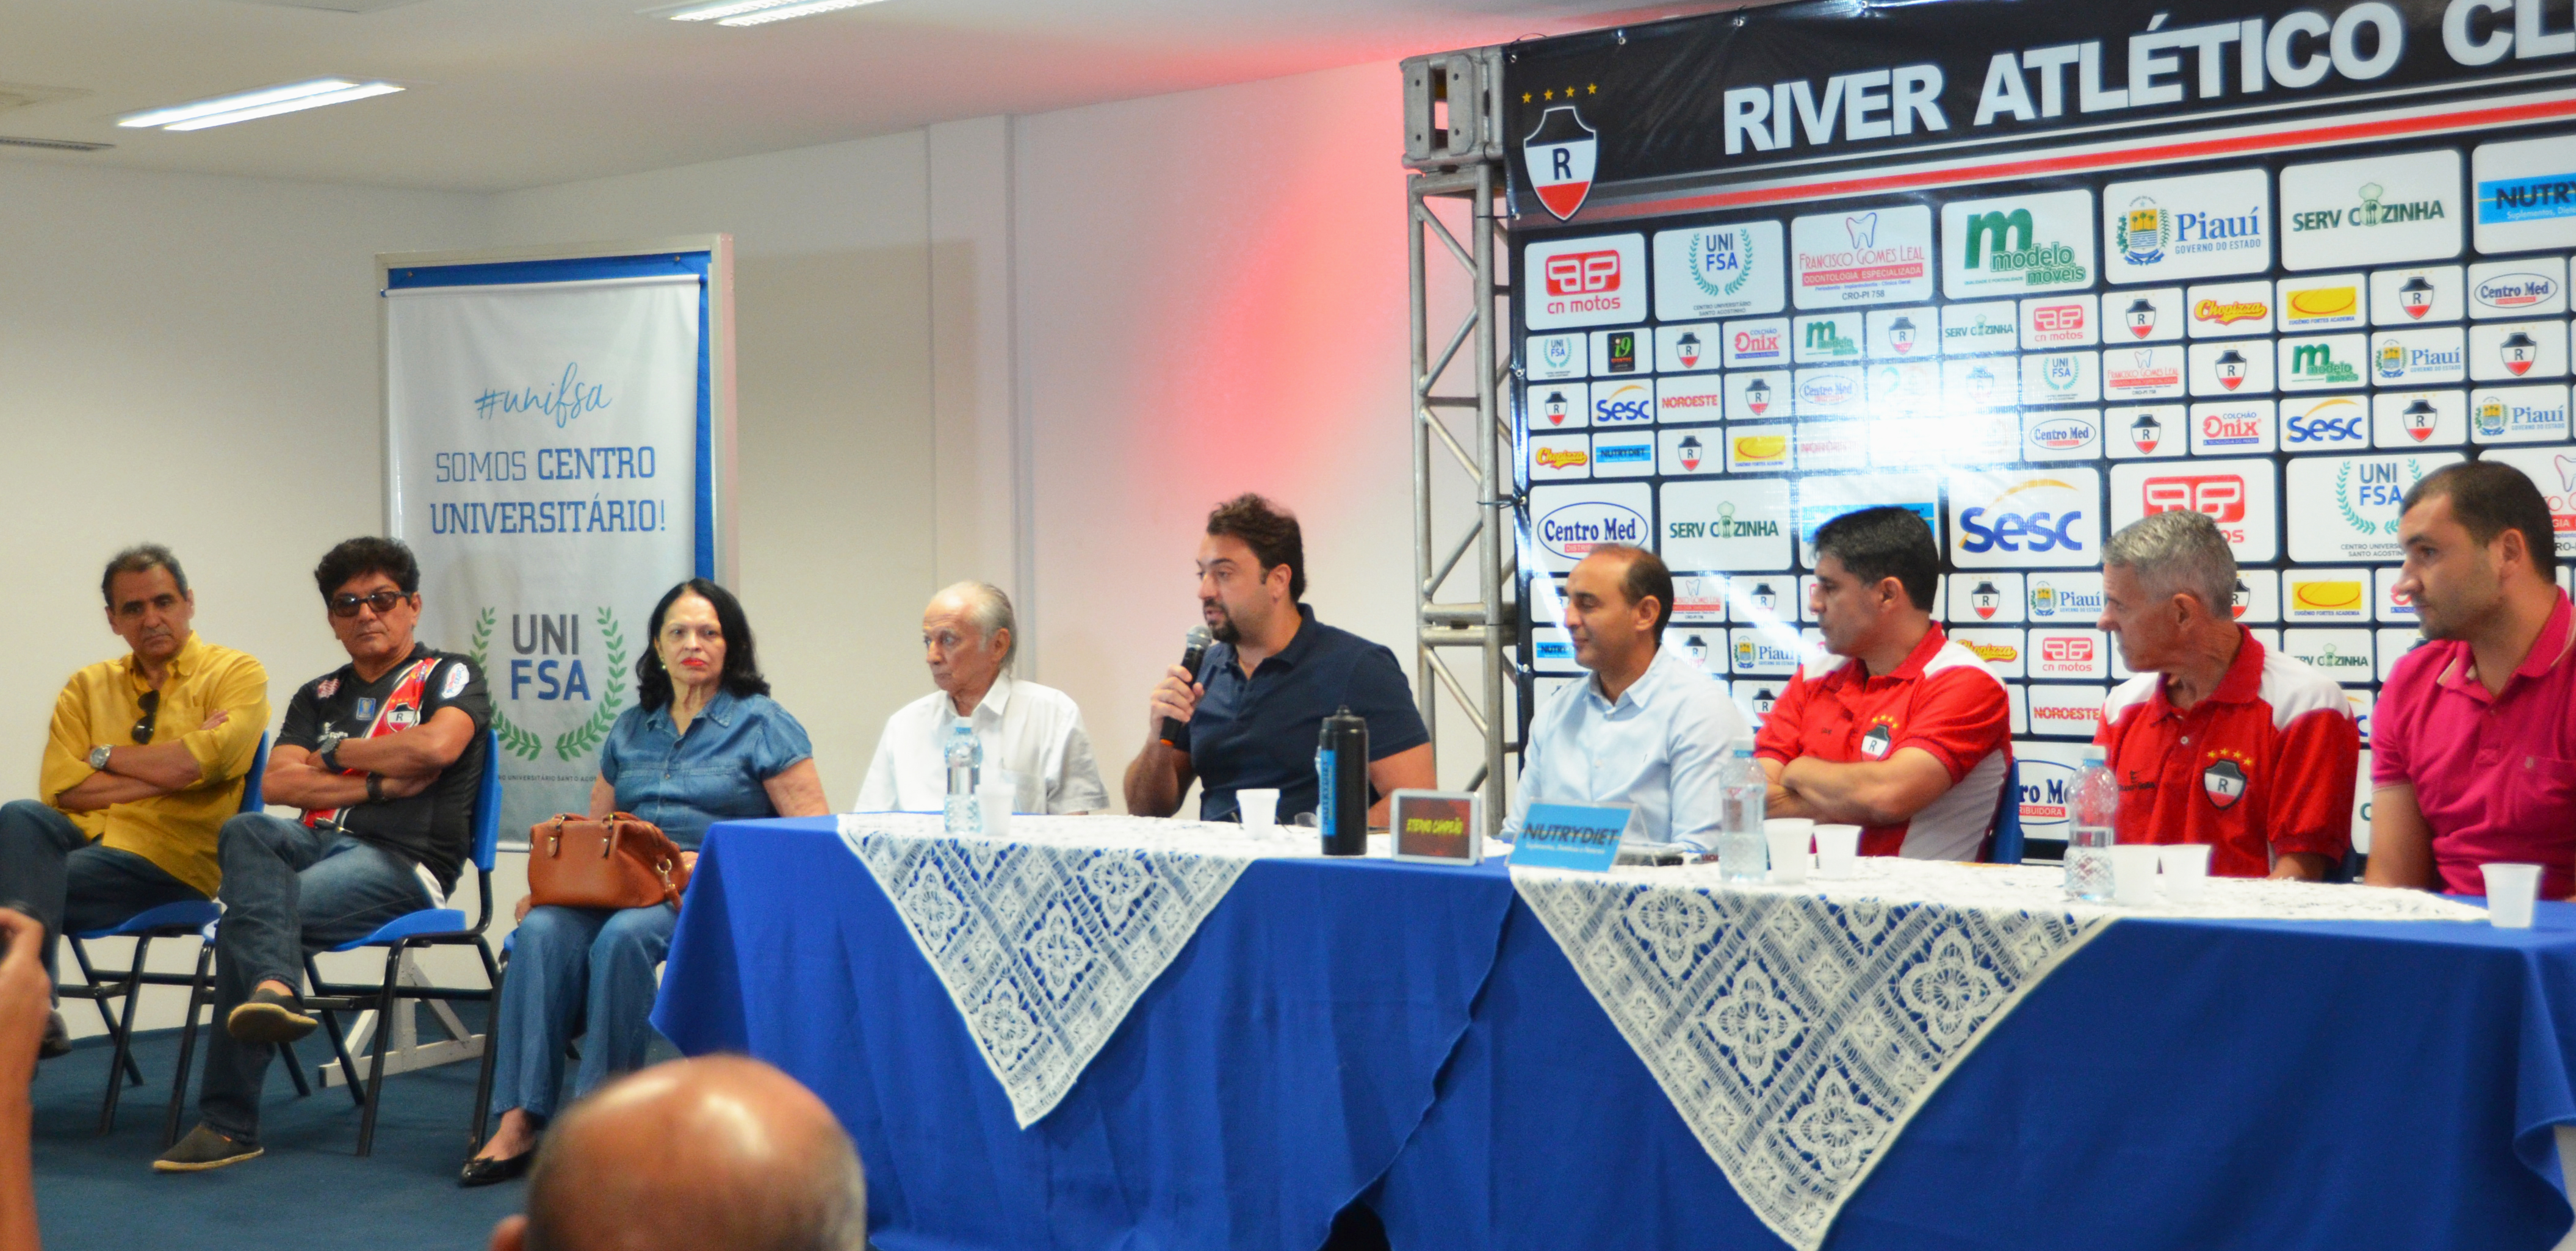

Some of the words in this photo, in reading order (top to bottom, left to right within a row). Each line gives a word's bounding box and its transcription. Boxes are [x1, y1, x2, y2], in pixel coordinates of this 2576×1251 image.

[1723, 63, 1949, 156] RIVER
[1974, 1, 2404, 127] ATLÉTICO
[2441, 0, 2576, 67] CL
[1551, 148, 1573, 181] R
[2174, 206, 2260, 242] Piauí
[2292, 209, 2342, 232] SERV
[1705, 233, 1734, 252] UNI
[2174, 242, 2213, 254] GOVERNO
[2215, 242, 2227, 251] DO
[2229, 239, 2261, 250] ESTADO
[1706, 252, 1739, 272] FSA
[1799, 252, 1853, 270] FRANCISCO
[1856, 248, 1897, 265] GOMES
[1900, 245, 1925, 262] LEAL
[1990, 241, 2075, 273] modelo
[1804, 273, 1858, 284] ODONTOLOGIA
[1861, 267, 1922, 279] ESPECIALIZADA
[2026, 262, 2086, 286] móveis
[1842, 290, 1870, 300] CRO-PI
[2480, 284, 2521, 299] Centro
[2524, 281, 2549, 295] Med
[1547, 302, 1564, 314] cn
[1570, 295, 1621, 313] motos
[2413, 292, 2422, 304] R
[2195, 300, 2267, 323] Chopizza
[2138, 314, 2145, 325] R
[1899, 331, 1906, 341] R
[1945, 327, 1966, 337] SERV
[2035, 333, 2046, 342] cn
[2049, 330, 2083, 341] motos
[1551, 339, 1564, 348] UNI
[1734, 332, 1779, 352] Onix
[1551, 348, 1565, 356] FSA
[1686, 346, 1692, 355] R
[2411, 347, 2460, 366] Piauí
[2514, 348, 2524, 361] R
[2052, 358, 2068, 367] UNI
[2052, 367, 2071, 377] FSA
[2228, 364, 2235, 377] R
[474, 362, 612, 428] #unifsa
[1661, 394, 1718, 409] NOROESTE
[1755, 392, 1762, 402] R
[1553, 404, 1560, 414] R
[1596, 399, 1650, 422] Sesc
[2223, 411, 2257, 419] COLCHÃO
[2512, 405, 2564, 424] Piauí
[2203, 415, 2259, 438] Onix
[2415, 415, 2424, 427] R
[2035, 428, 2067, 441] Centro
[2070, 427, 2089, 439] Med
[2143, 429, 2150, 440] R
[2287, 416, 2363, 443] Sesc
[1687, 449, 1693, 459] R
[436, 450, 526, 482] SOMOS
[538, 446, 656, 480] CENTRO
[2359, 462, 2397, 483] UNI
[2359, 485, 2405, 506] FSA
[430, 492, 666, 534] UNIVERSITÁRIO!
[1545, 519, 1599, 541] Centro
[1604, 517, 1636, 540] Med
[1670, 522, 1705, 538] SERV
[1959, 507, 2083, 553] Sesc
[1760, 596, 1767, 605] R
[1982, 596, 1990, 606] R
[2059, 591, 2101, 607] Piauí
[512, 613, 579, 655] UNI
[1692, 647, 1698, 656] R
[2043, 663, 2054, 672] cn
[2058, 662, 2093, 672] motos
[511, 659, 591, 701] FSA
[1762, 702, 1769, 712] R
[2033, 707, 2100, 721] NOROESTE
[396, 713, 403, 721] R
[1869, 740, 1877, 752] R
[2217, 778, 2228, 791] R
[2019, 806, 2063, 816] RIBUIDORA
[1522, 822, 1620, 845] NUTRYDIET
